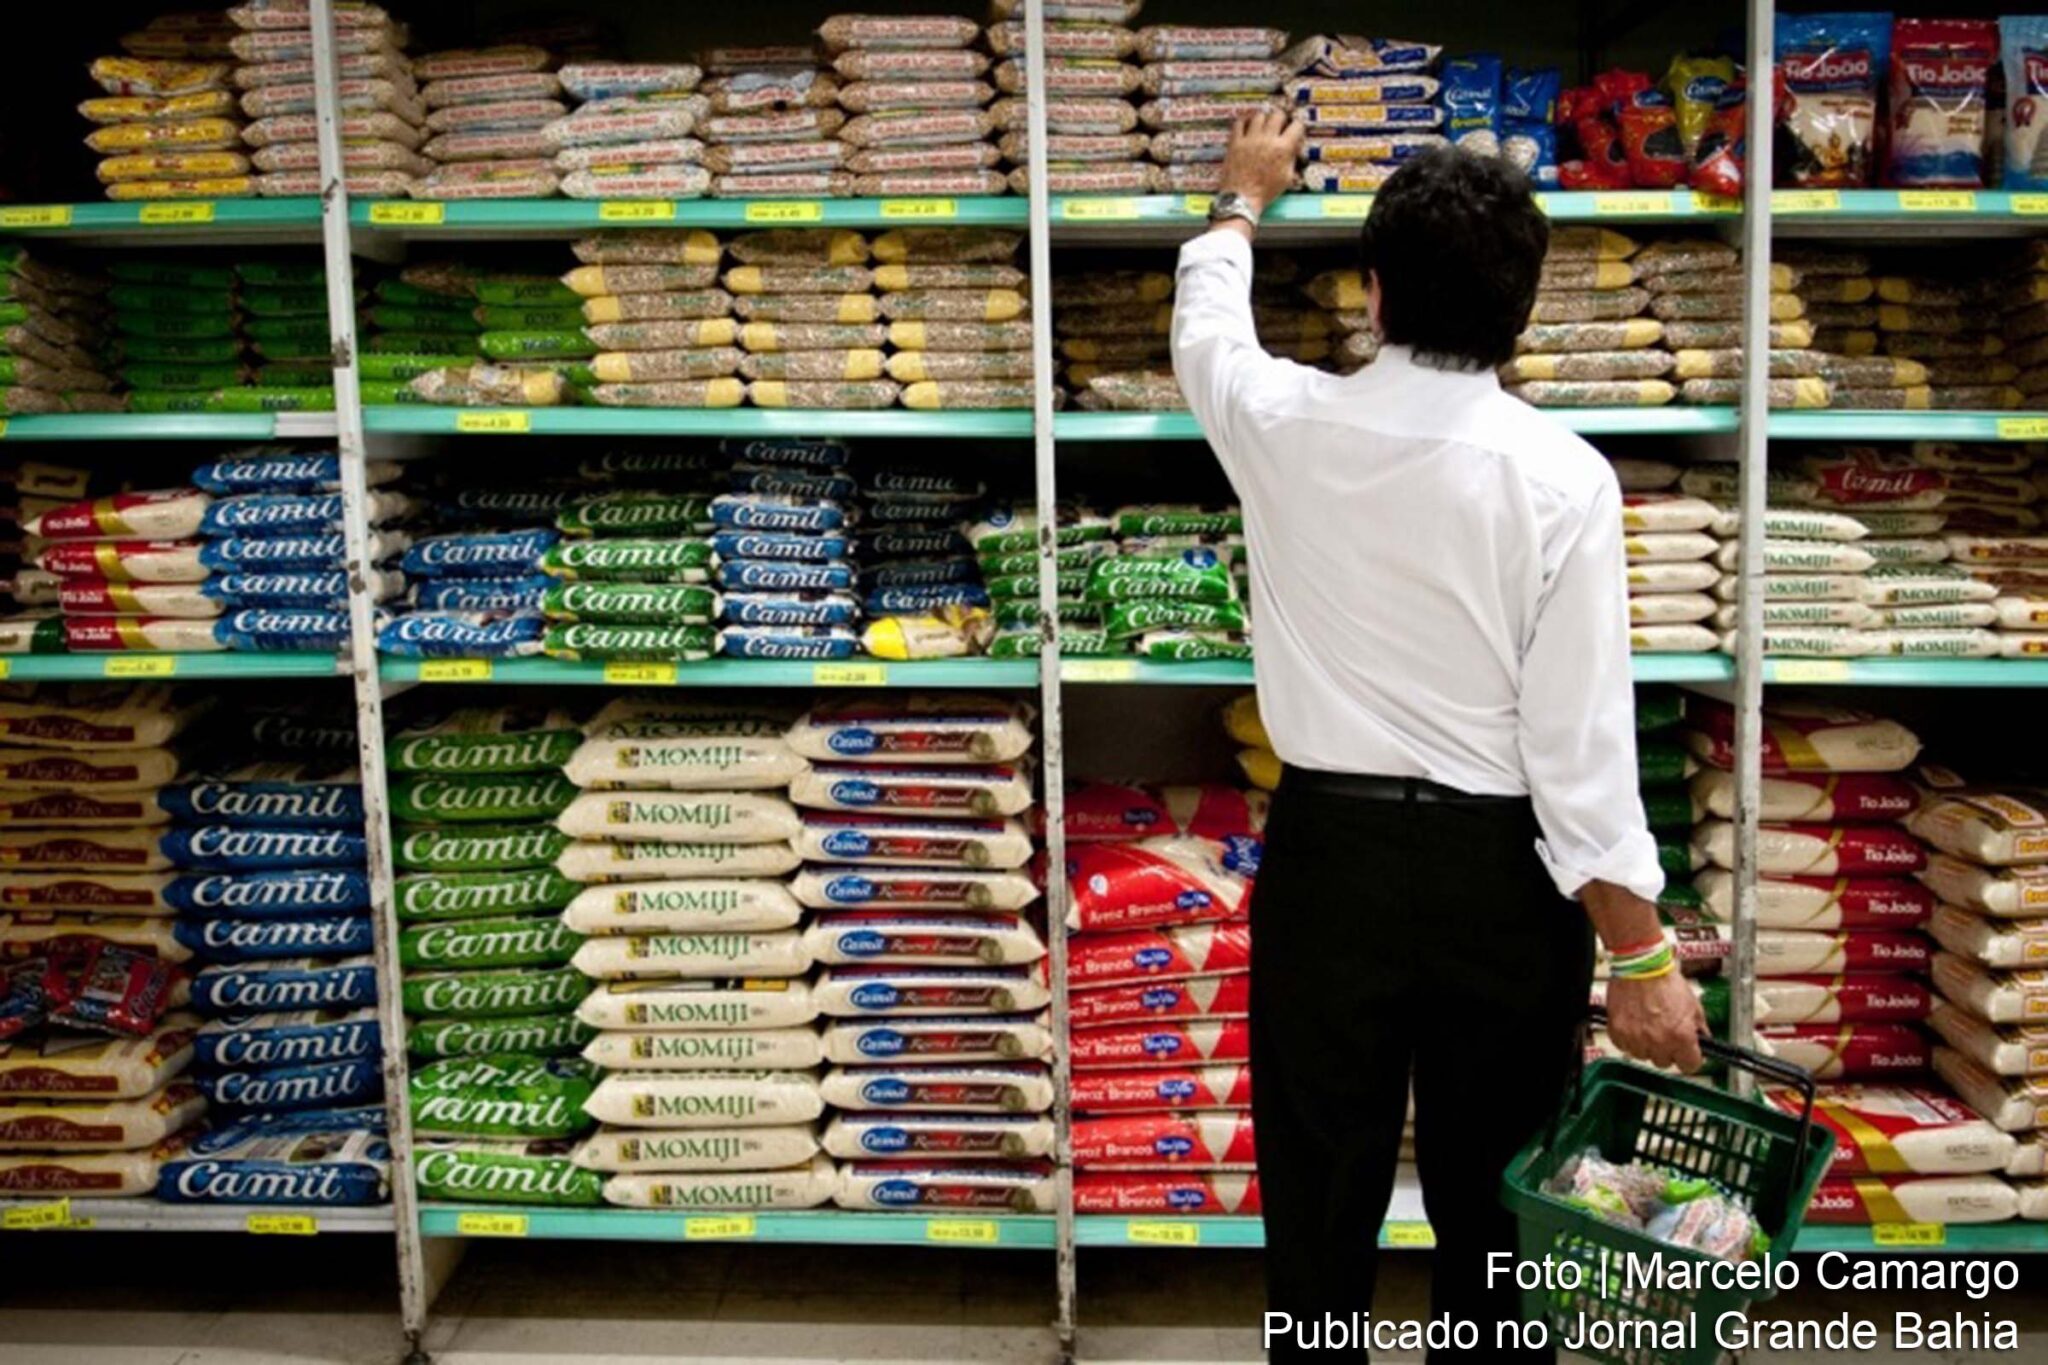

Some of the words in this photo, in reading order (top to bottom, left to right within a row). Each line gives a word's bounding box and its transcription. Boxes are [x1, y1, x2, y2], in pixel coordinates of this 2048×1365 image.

[1907, 64, 1936, 83] Tio
[744, 440, 829, 464] Camil
[211, 456, 326, 481] Camil
[1840, 467, 1914, 493] Camil
[215, 496, 339, 526] Camil
[577, 497, 698, 526] Camil
[733, 504, 826, 529] Camil
[1143, 515, 1231, 533] Camil
[220, 534, 347, 559] Camil
[421, 535, 538, 565] Camil
[561, 542, 690, 567] Camil
[735, 535, 826, 558] Camil
[220, 572, 345, 594] Camil
[741, 563, 832, 588] Camil
[1108, 575, 1204, 598] Camil
[561, 585, 690, 613] Camil
[740, 600, 832, 625] Camil
[399, 617, 518, 643] Camil
[563, 622, 692, 650] Camil
[743, 634, 835, 658] Camil
[402, 733, 560, 769] Camil
[643, 746, 742, 771] MOMIJI
[190, 782, 348, 818] Camil
[410, 778, 564, 811] Camil
[633, 803, 732, 829] MOMIJI
[189, 825, 348, 857] Camil
[402, 828, 553, 863] Camil
[637, 842, 737, 864] MOMIJI
[191, 872, 350, 906] Camil
[404, 873, 559, 913] Camil
[641, 890, 738, 915] MOMIJI
[203, 917, 360, 948] Camil
[416, 922, 570, 960] Camil
[652, 936, 750, 960] MOMIJI
[209, 969, 363, 1008] Camil
[423, 974, 577, 1012] Camil
[650, 1003, 748, 1026] MOMIJI
[214, 1025, 370, 1063] Camil
[435, 1017, 587, 1056] Camil
[656, 1036, 754, 1062] MOMIJI
[214, 1065, 360, 1105] Camil
[657, 1095, 755, 1119] MOMIJI
[643, 1137, 741, 1163] MOMIJI
[178, 1161, 345, 1199] Camil
[416, 1151, 582, 1195] Camil
[675, 1184, 774, 1208] MOMIJI
